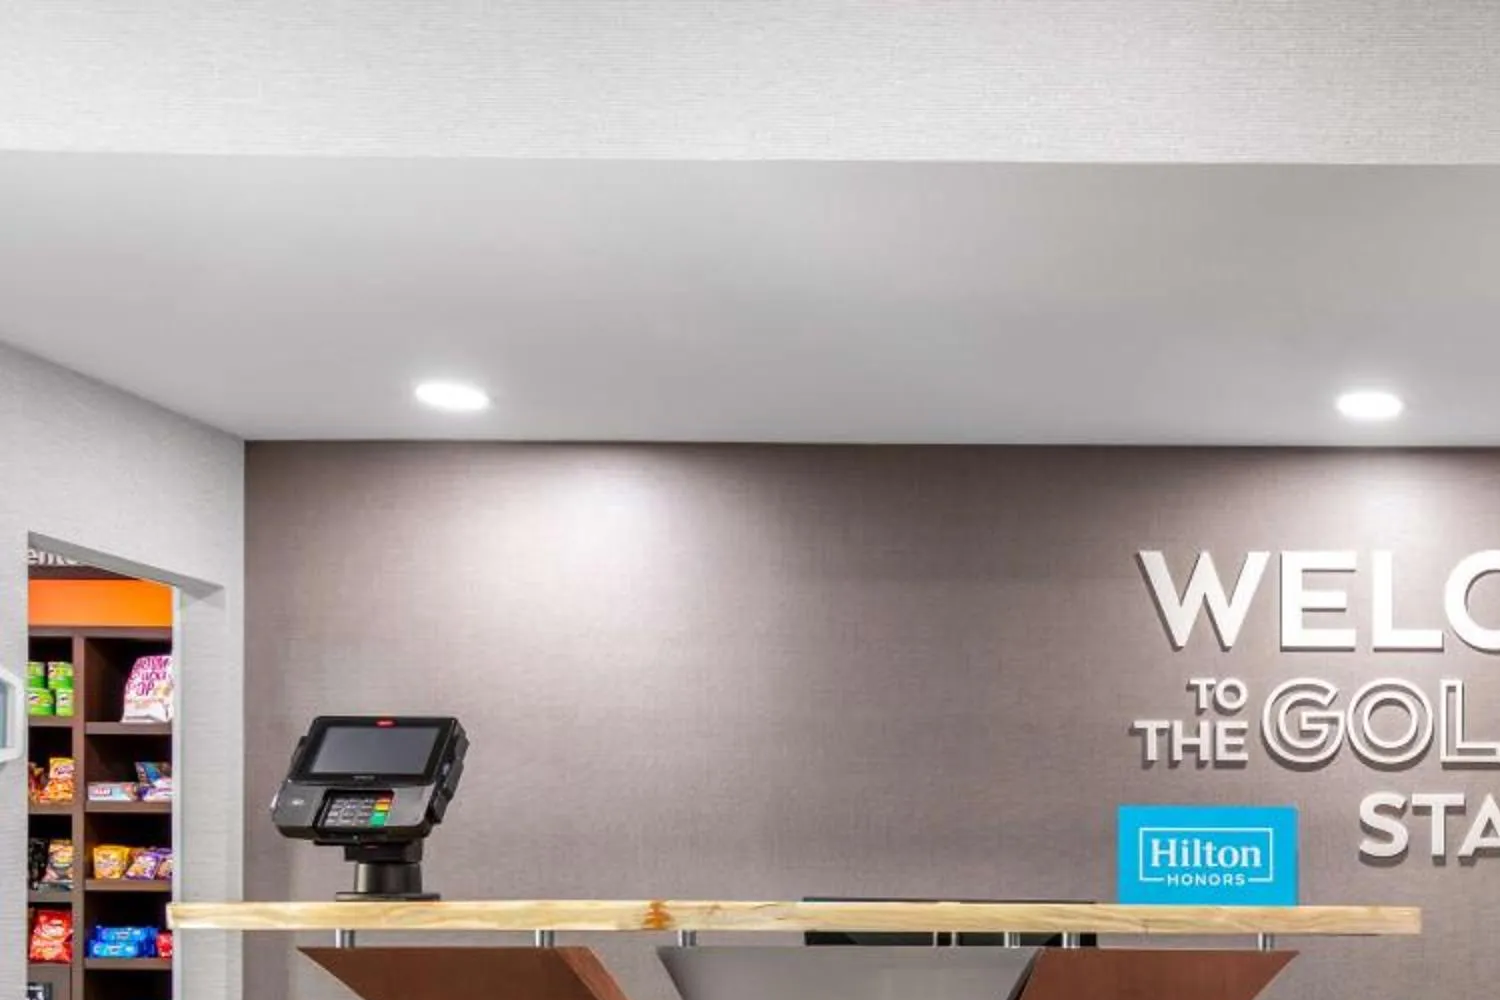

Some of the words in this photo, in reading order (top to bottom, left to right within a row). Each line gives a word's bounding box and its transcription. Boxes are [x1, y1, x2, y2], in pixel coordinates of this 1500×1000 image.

[1188, 678, 1248, 710] TO
[1132, 719, 1249, 762] THE
[1151, 837, 1263, 869] Hilton
[1167, 873, 1246, 887] HONORS
